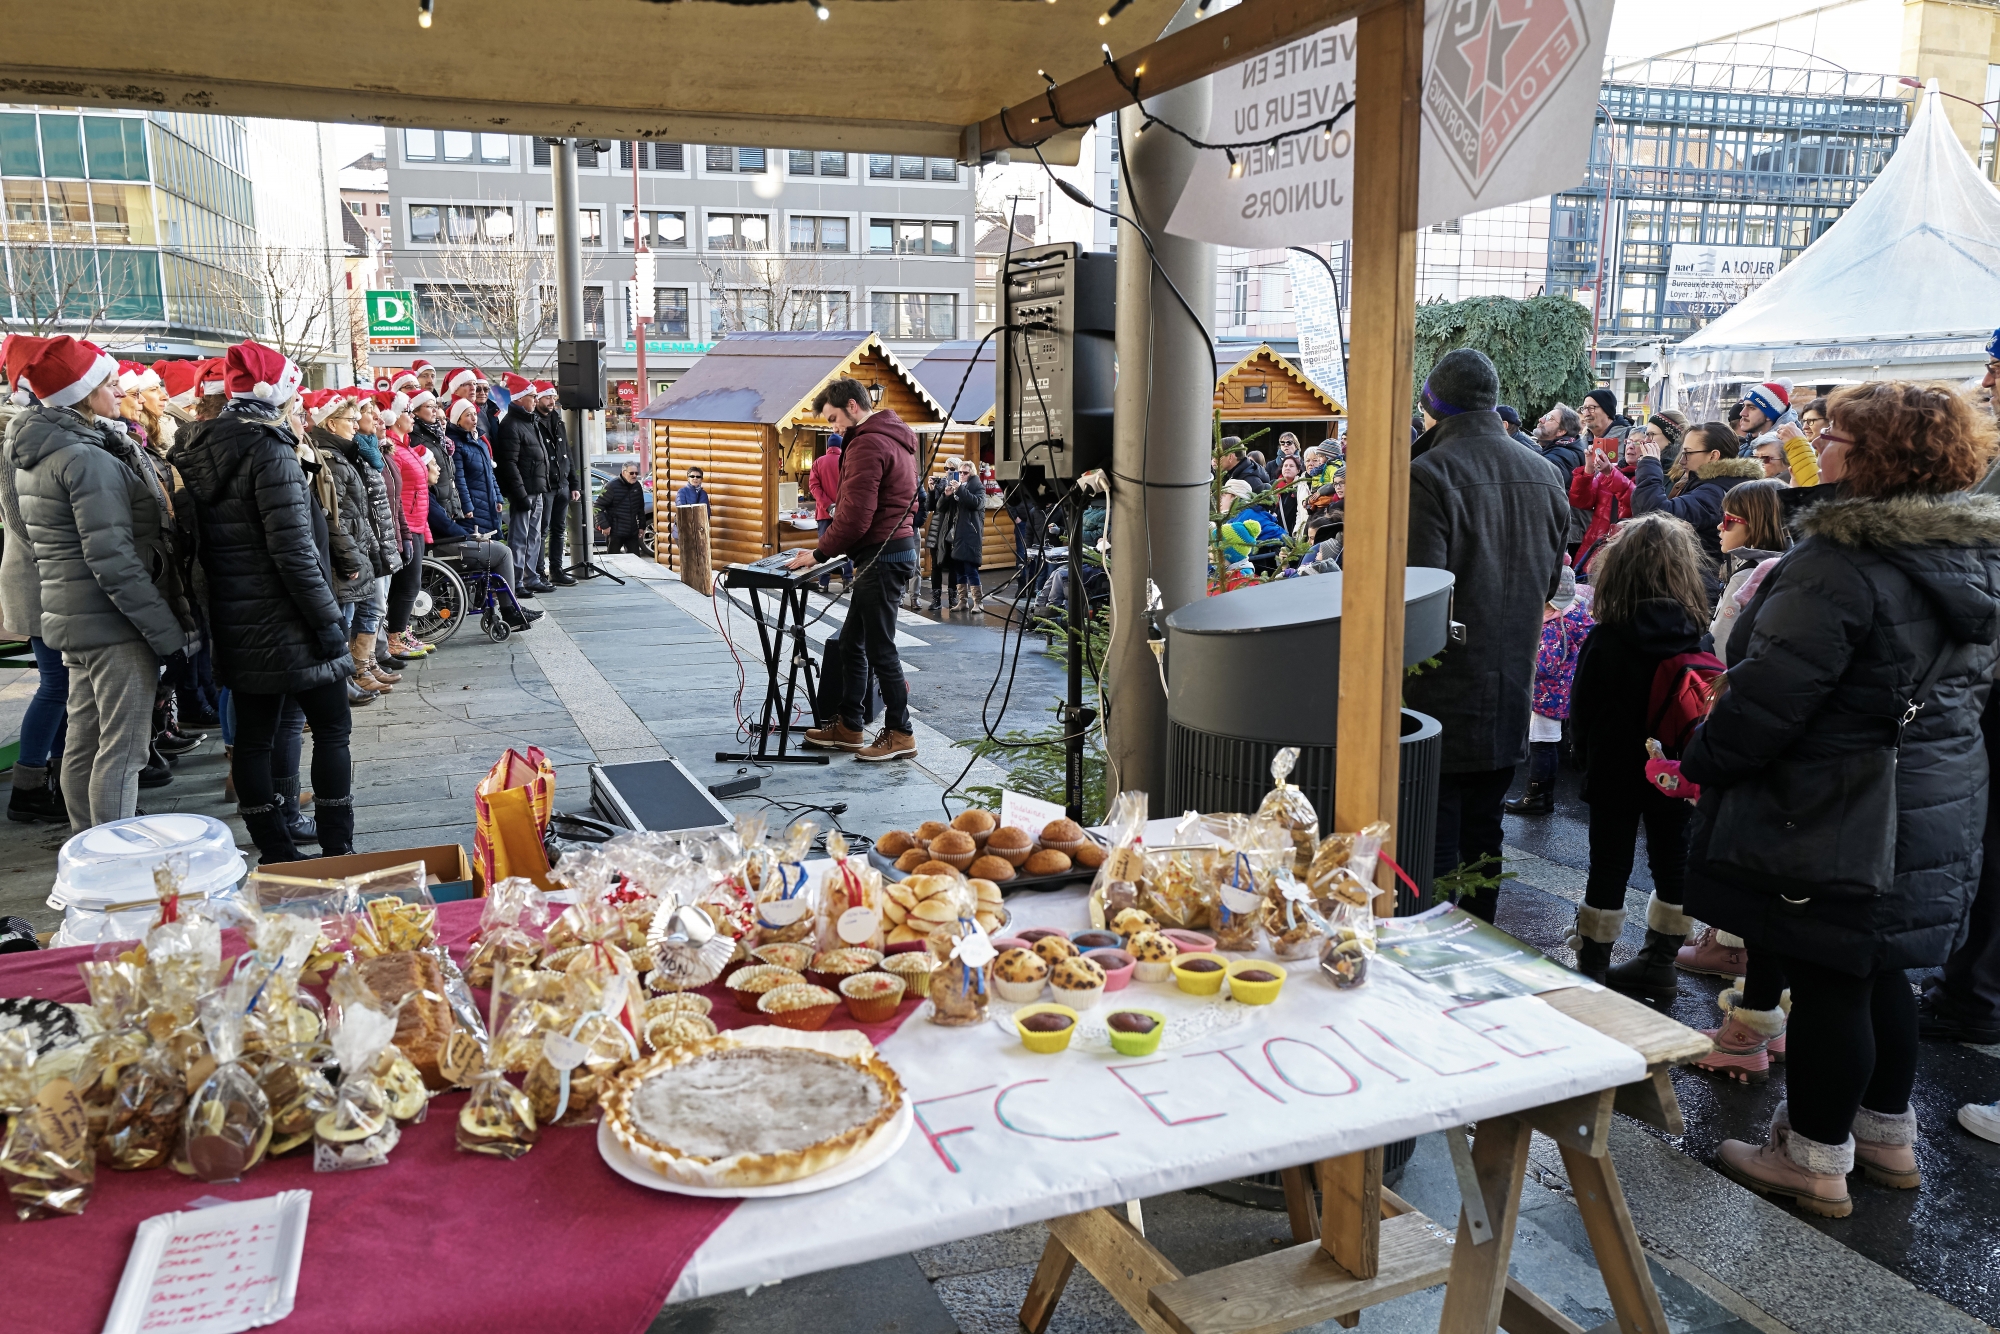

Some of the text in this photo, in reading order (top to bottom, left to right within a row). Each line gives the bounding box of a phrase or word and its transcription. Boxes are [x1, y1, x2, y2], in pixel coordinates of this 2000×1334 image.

[1721, 261, 1775, 274] A LOUER
[1670, 291, 1689, 299] Loyer
[377, 296, 405, 323] D
[1688, 303, 1705, 314] 032
[1707, 304, 1725, 314] 737
[625, 341, 717, 353] DSENBAC
[912, 1000, 1571, 1174] FC ETOILE
